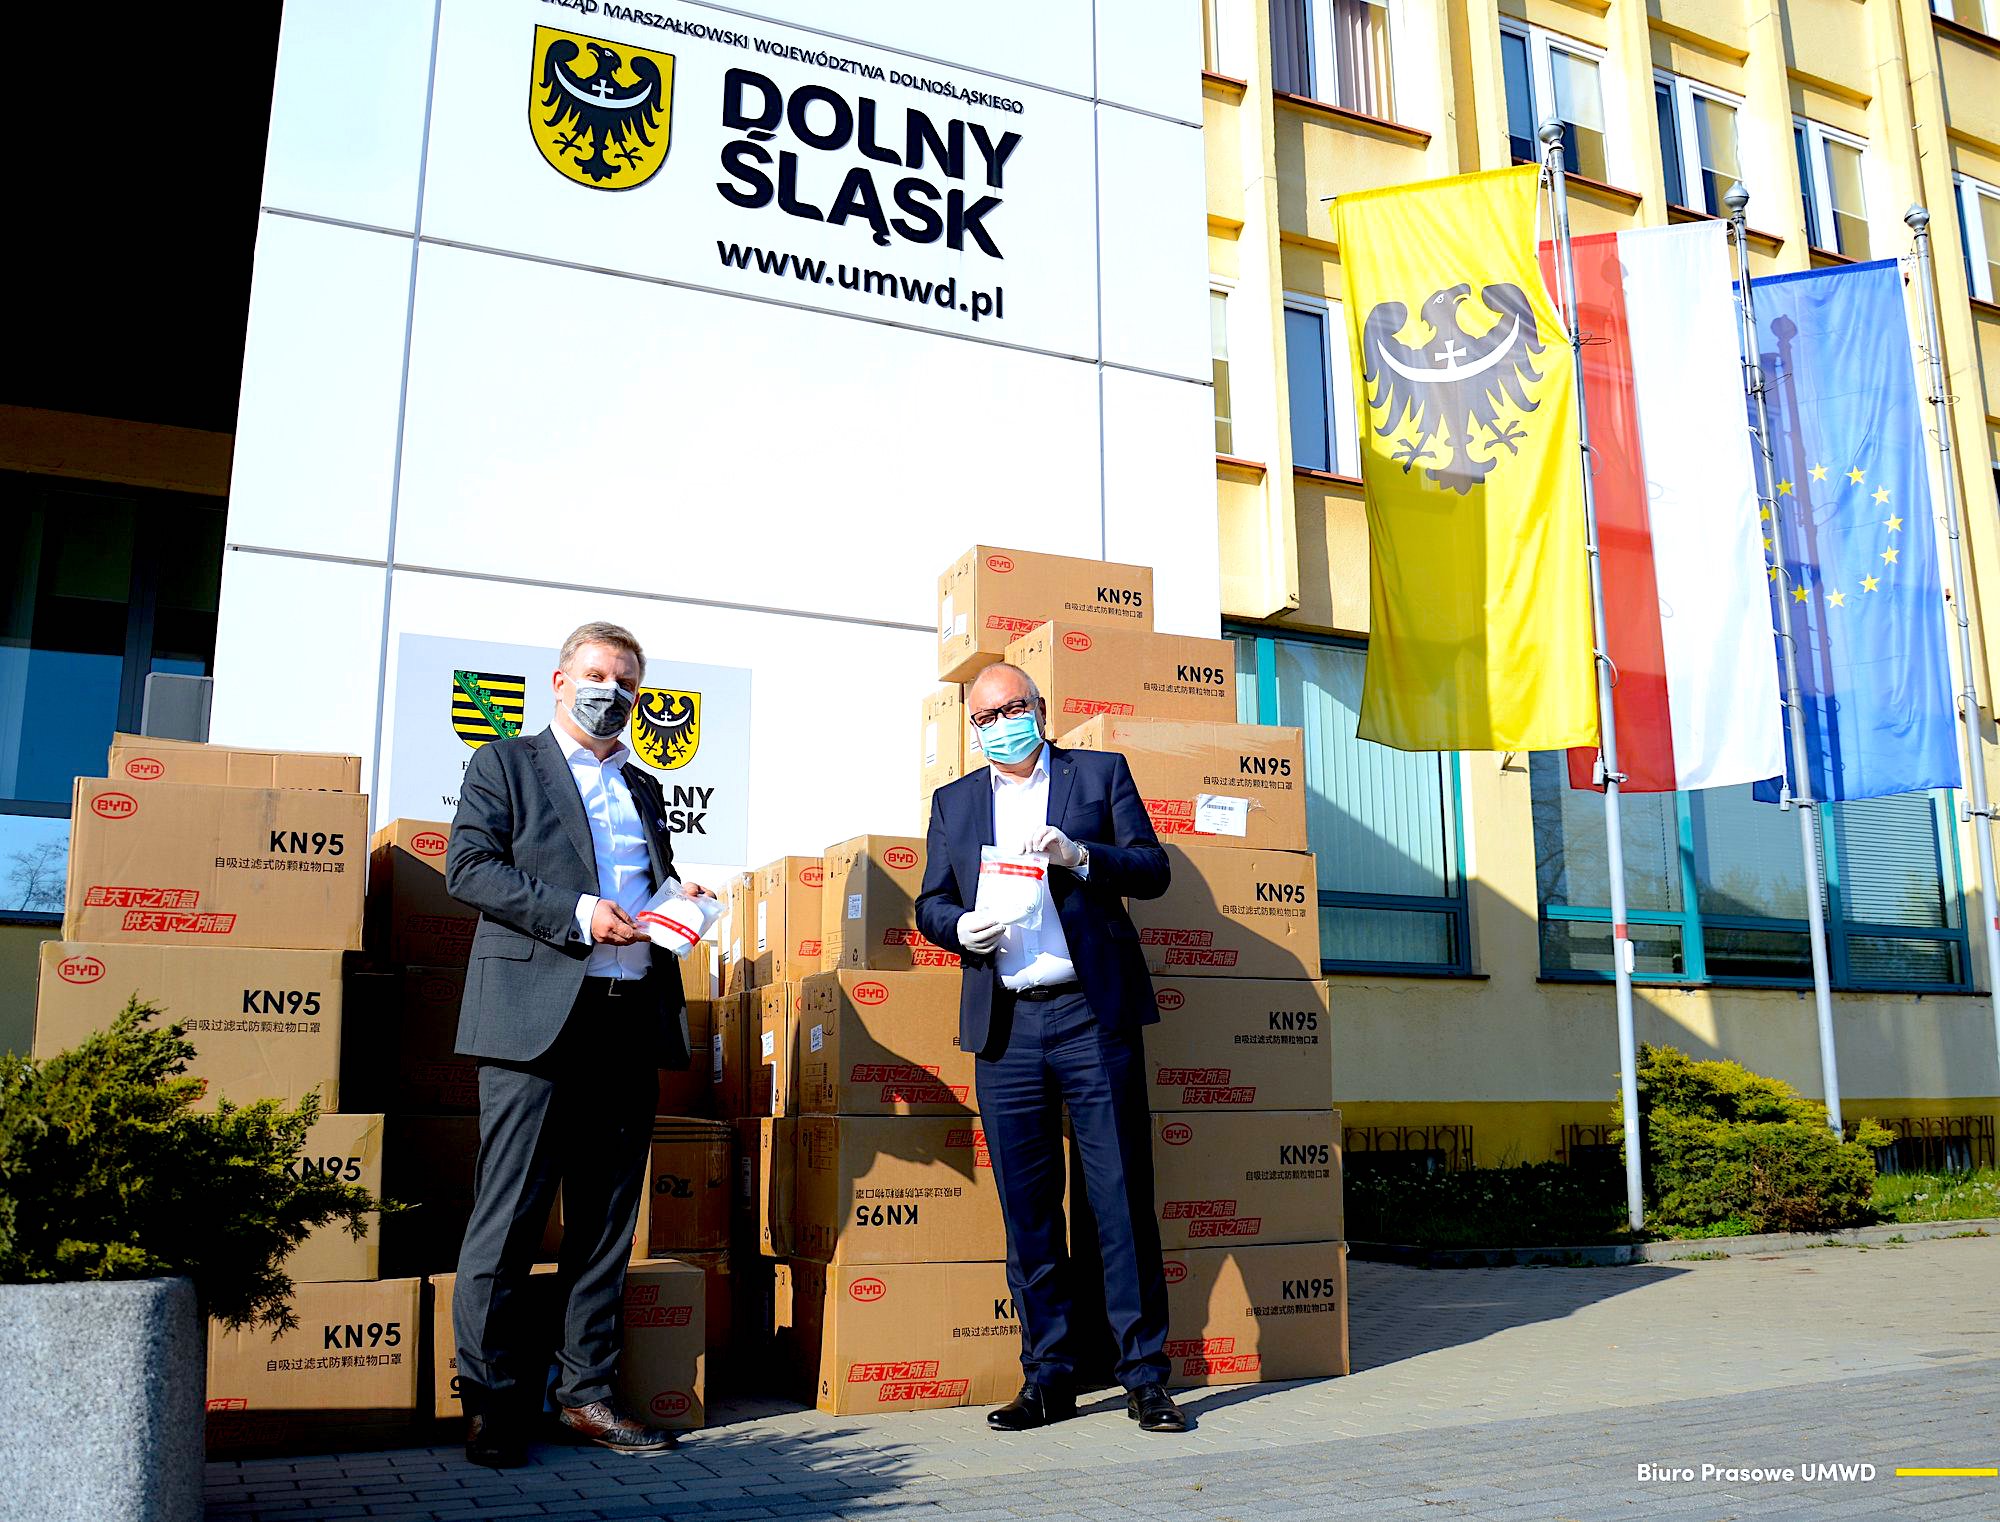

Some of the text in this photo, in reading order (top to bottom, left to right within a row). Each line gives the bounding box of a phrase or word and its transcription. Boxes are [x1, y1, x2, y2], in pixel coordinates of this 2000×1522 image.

[603, 3, 749, 49] MARSZAŁKOWSKI
[754, 37, 884, 80] WOJEWÓDZTWA
[890, 70, 1024, 115] DOLNOŚLĄSKIEGO
[722, 68, 1023, 189] DOLNY
[716, 130, 1005, 260] ŚLĄSK
[716, 240, 1005, 323] www.umwd.pl
[989, 559, 1011, 569] BYD
[1097, 586, 1143, 607] KN95
[1066, 636, 1089, 647] BYD
[1177, 665, 1225, 685] KN95
[130, 763, 160, 775] BYD
[1239, 755, 1291, 776] KN95
[97, 800, 132, 812] BYD
[270, 831, 344, 856] KN95
[416, 838, 445, 850] BYD
[214, 857, 345, 874] 自吸过滤式防颗粒物口罩
[888, 852, 914, 863] BYD
[84, 886, 200, 908] 急天下之所急
[1256, 882, 1306, 904] KN95
[121, 913, 238, 935] 供天下之所需
[64, 963, 99, 976] BYD
[242, 989, 321, 1016] KN95
[857, 988, 884, 999] BYD
[1157, 994, 1182, 1005] BYD
[186, 1018, 321, 1034] 自吸过滤式防颗粒物口罩
[1269, 1011, 1318, 1031] KN95
[1165, 1130, 1189, 1139] BYD
[1280, 1144, 1329, 1165] KN95
[857, 1204, 918, 1226] KN95
[853, 1284, 882, 1295] BYD
[1282, 1279, 1334, 1300] KN95
[324, 1322, 402, 1350] KN95
[265, 1352, 402, 1373] 自吸过滤式防颗粒物口罩
[848, 1361, 940, 1382] 急天下之所急
[878, 1379, 969, 1402] 供天下之所需
